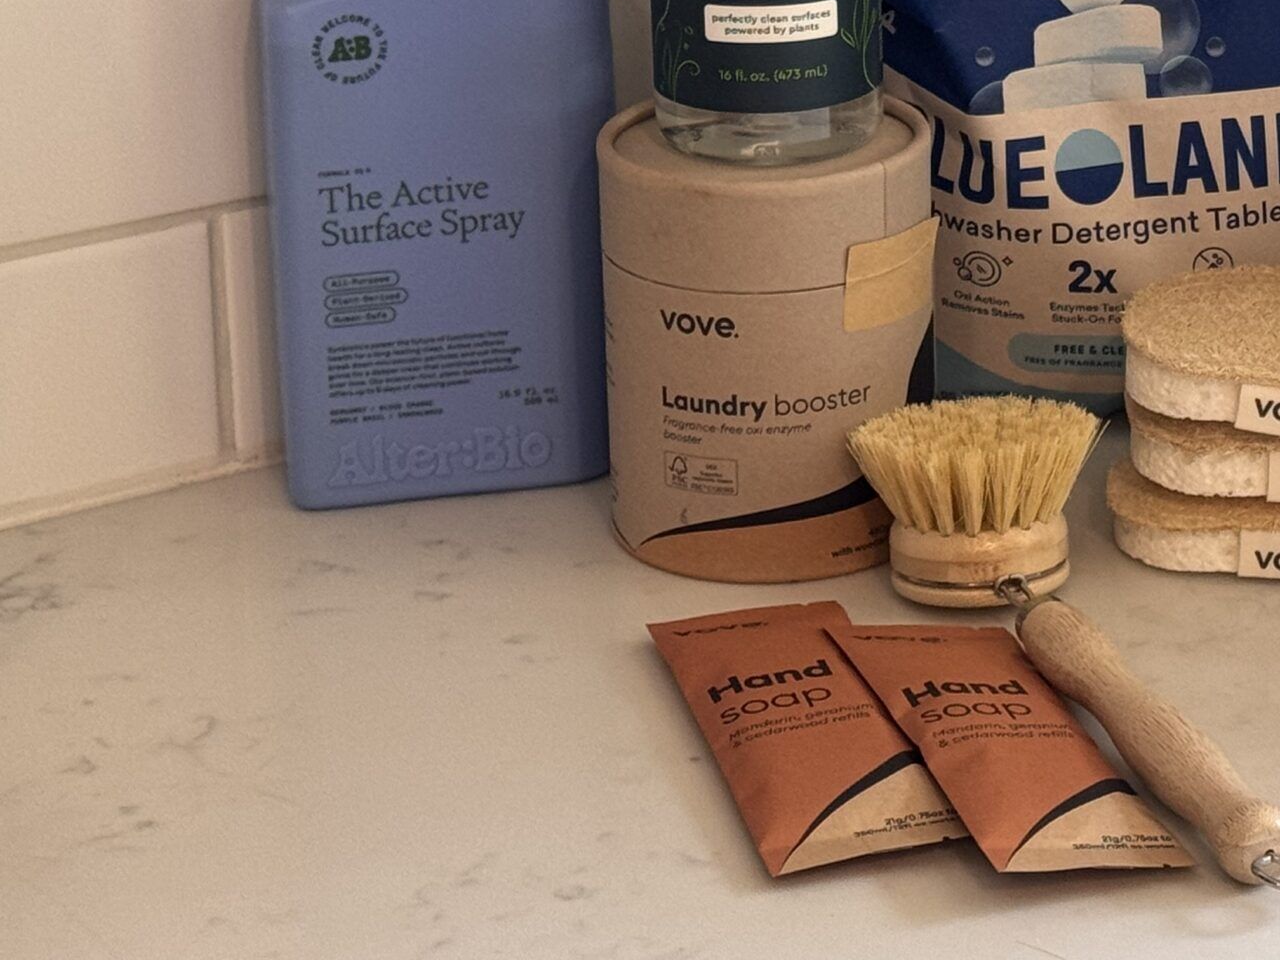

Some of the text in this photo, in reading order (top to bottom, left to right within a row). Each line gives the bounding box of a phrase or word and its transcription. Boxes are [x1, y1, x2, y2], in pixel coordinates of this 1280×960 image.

[711, 10, 831, 25] perfectly clean surfaces
[724, 23, 819, 36] powered by plants
[719, 69, 732, 81] 16
[774, 67, 801, 83] (473
[805, 63, 828, 79] mL)
[317, 176, 490, 214] The Active
[321, 208, 526, 248] Surface Spray
[1051, 210, 1199, 245] Detergent
[1068, 259, 1118, 294] 2x
[953, 289, 1010, 307] Oxi Action
[1049, 301, 1099, 314] Enzymes
[660, 308, 740, 339] vove.
[991, 307, 1025, 320] Stains
[1052, 313, 1105, 325] Stuck-On
[1054, 344, 1084, 356] FREE
[661, 384, 872, 422] Laundry booster
[662, 414, 813, 437] Fragrance-free oxi enzyme
[664, 430, 702, 445] booster
[707, 657, 833, 705] Hand
[902, 679, 1030, 709] Hand
[719, 686, 833, 726] soap
[920, 701, 1032, 725] soap
[745, 717, 829, 743] cedarwood
[831, 711, 871, 727] refills
[952, 730, 1034, 745] cedarwood
[1037, 730, 1076, 740] refills
